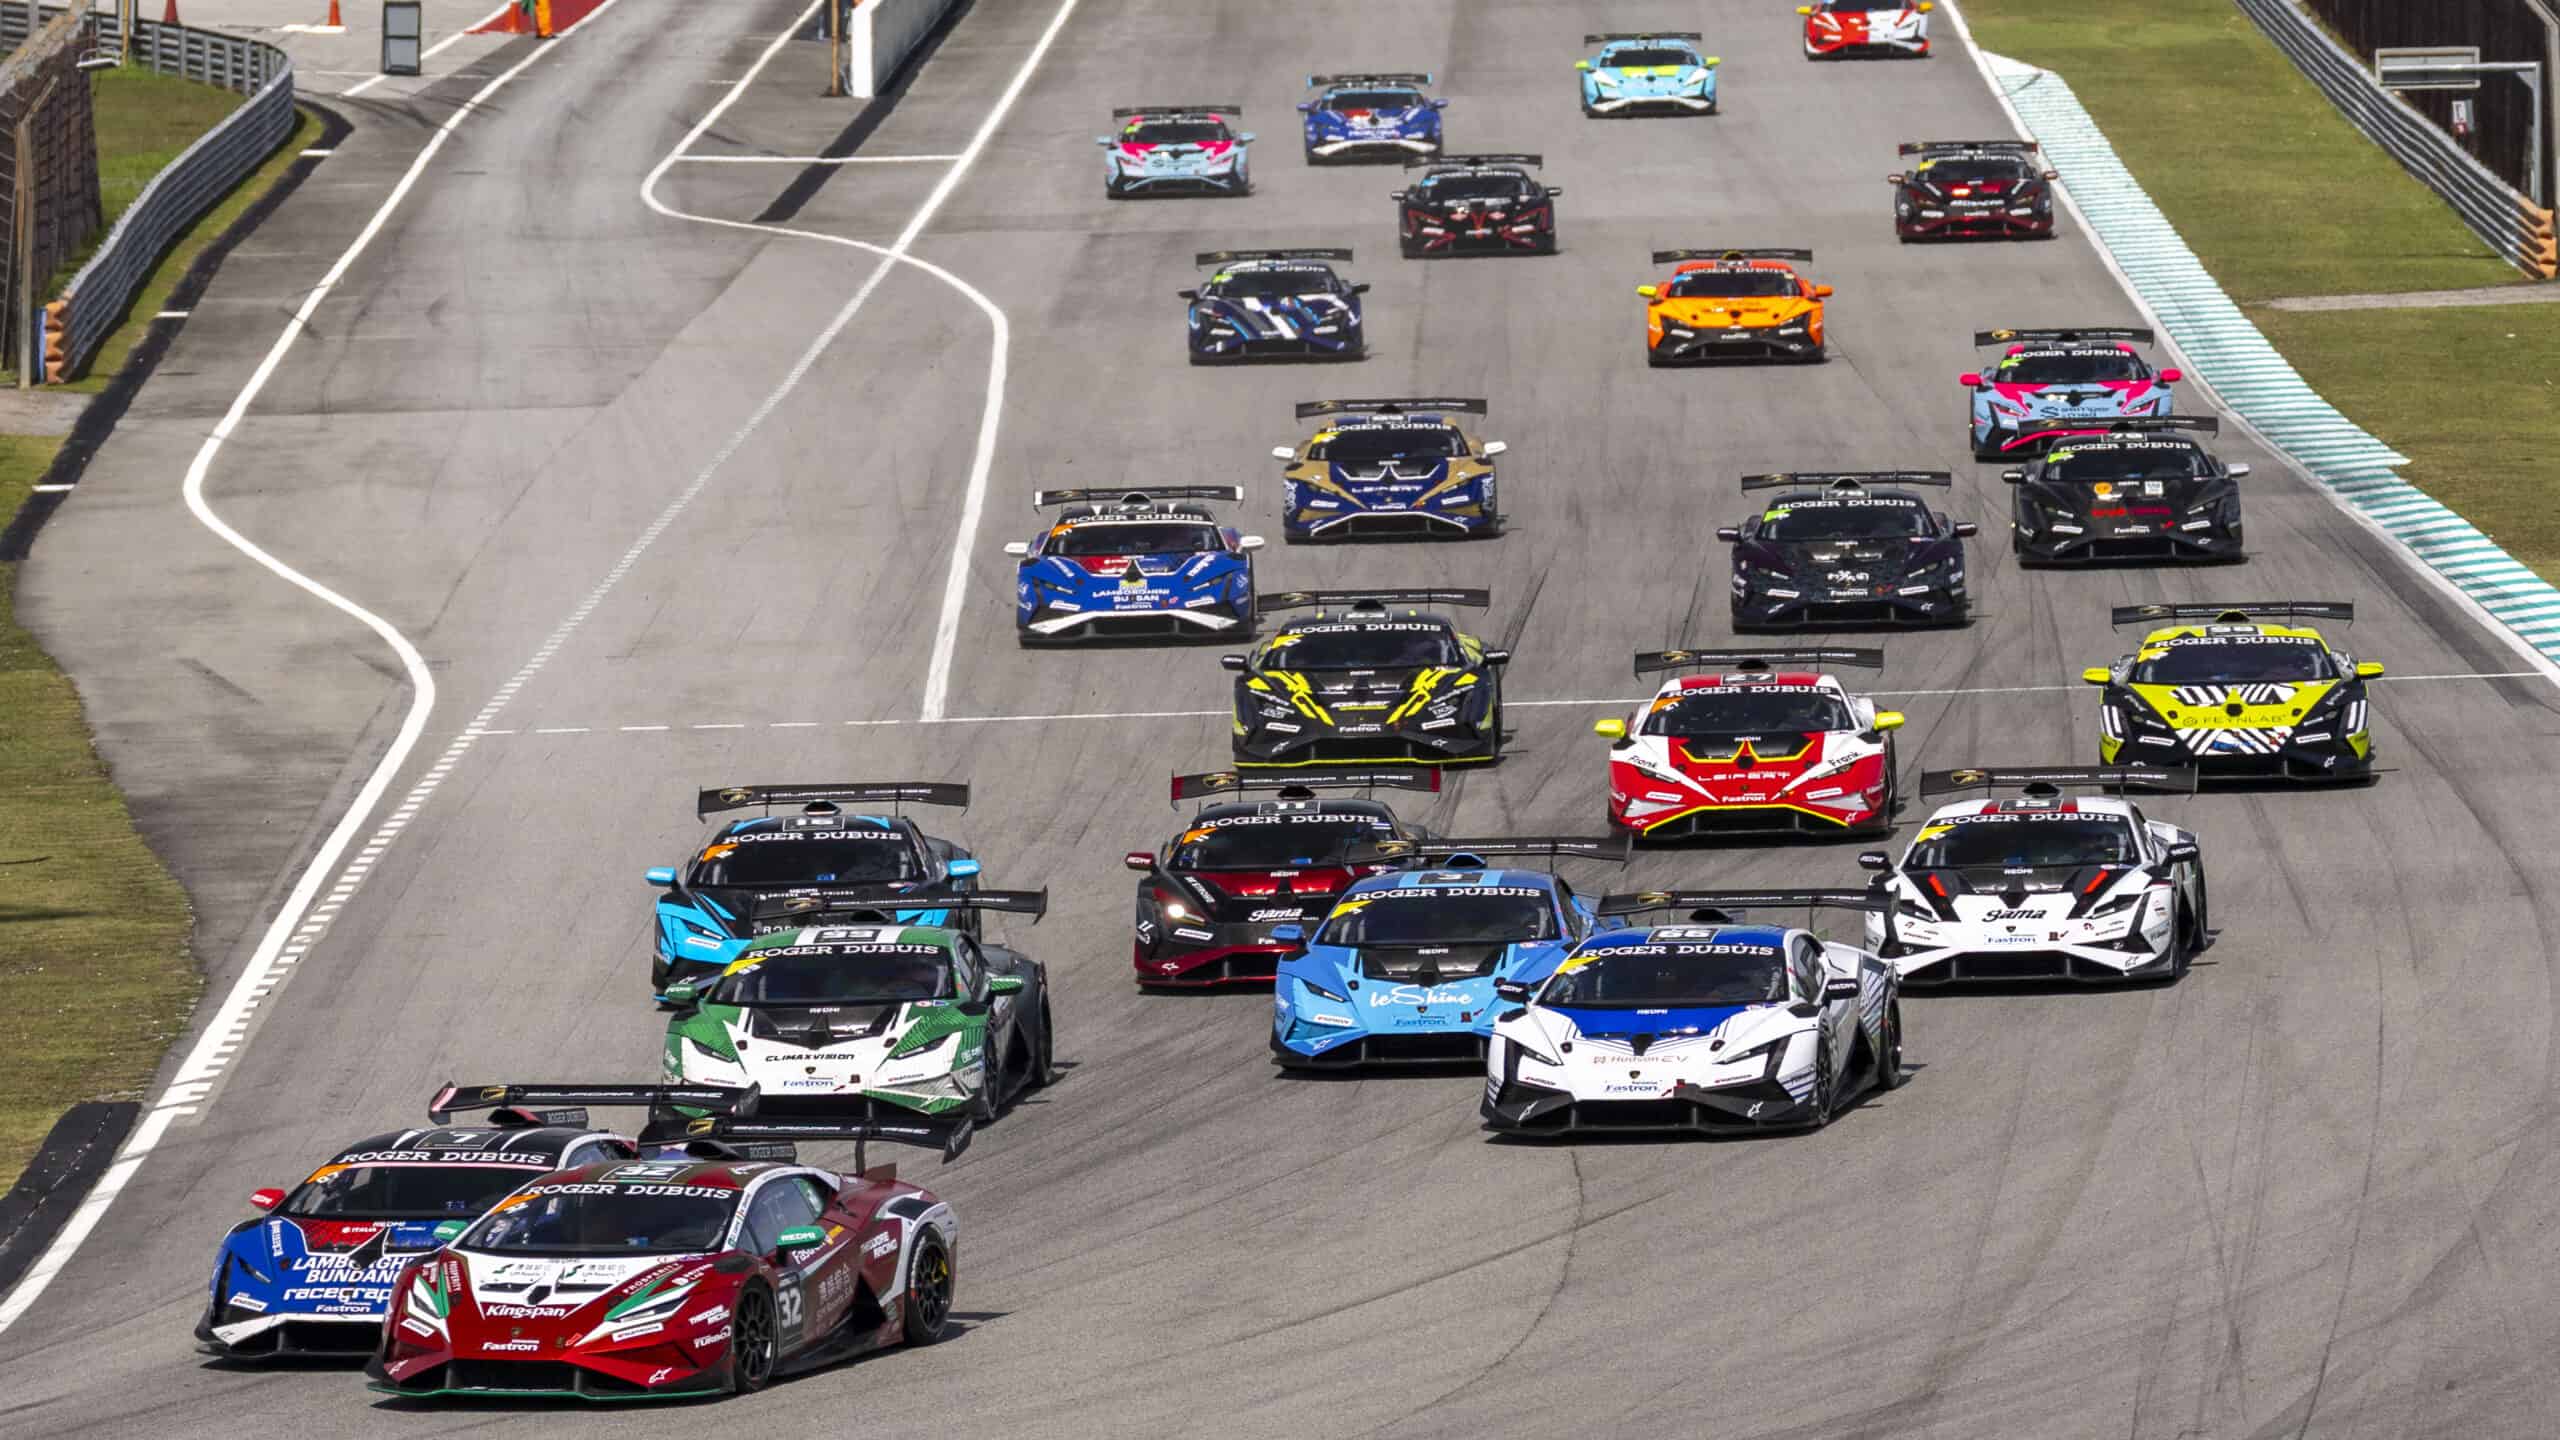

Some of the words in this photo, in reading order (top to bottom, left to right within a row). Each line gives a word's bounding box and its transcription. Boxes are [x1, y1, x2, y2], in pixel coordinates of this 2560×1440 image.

[1288, 624, 1359, 636] ROGER
[1365, 623, 1442, 632] DUBUIS
[2154, 636, 2229, 648] ROGER
[2235, 636, 2316, 646] DUBUIS
[1667, 686, 1742, 698] ROGER
[1751, 685, 1832, 695] DUBUIS
[1200, 816, 1281, 829] ROGER
[1291, 814, 1379, 824] DUBUIS
[1937, 812, 2021, 827] ROGER
[2029, 812, 2120, 823] DUBUIS
[723, 831, 805, 843] ROGER
[813, 831, 902, 841] DUBUIS
[1352, 888, 1437, 901] ROGER
[1447, 887, 1541, 897] DUBUIS
[1982, 909, 2048, 923] gama
[1987, 936, 2036, 944] Fastron
[747, 944, 833, 958] ROGER
[842, 944, 939, 955] DUBUIS
[1582, 945, 1667, 958] ROGER
[1677, 944, 1774, 956] DUBUIS
[783, 1080, 833, 1088] Fastron
[1605, 1083, 1659, 1093] Fastron
[450, 1131, 477, 1144] 7
[338, 1150, 429, 1164] ROGER
[440, 1150, 547, 1165] DUBUIS
[615, 1165, 678, 1177] 32
[525, 1184, 616, 1196] ROGER
[624, 1185, 732, 1199] DUBUIS
[315, 1303, 371, 1313] Fastron
[486, 1304, 566, 1319] Kingspan
[778, 1287, 802, 1329] 32
[482, 1341, 538, 1352] Fastron
